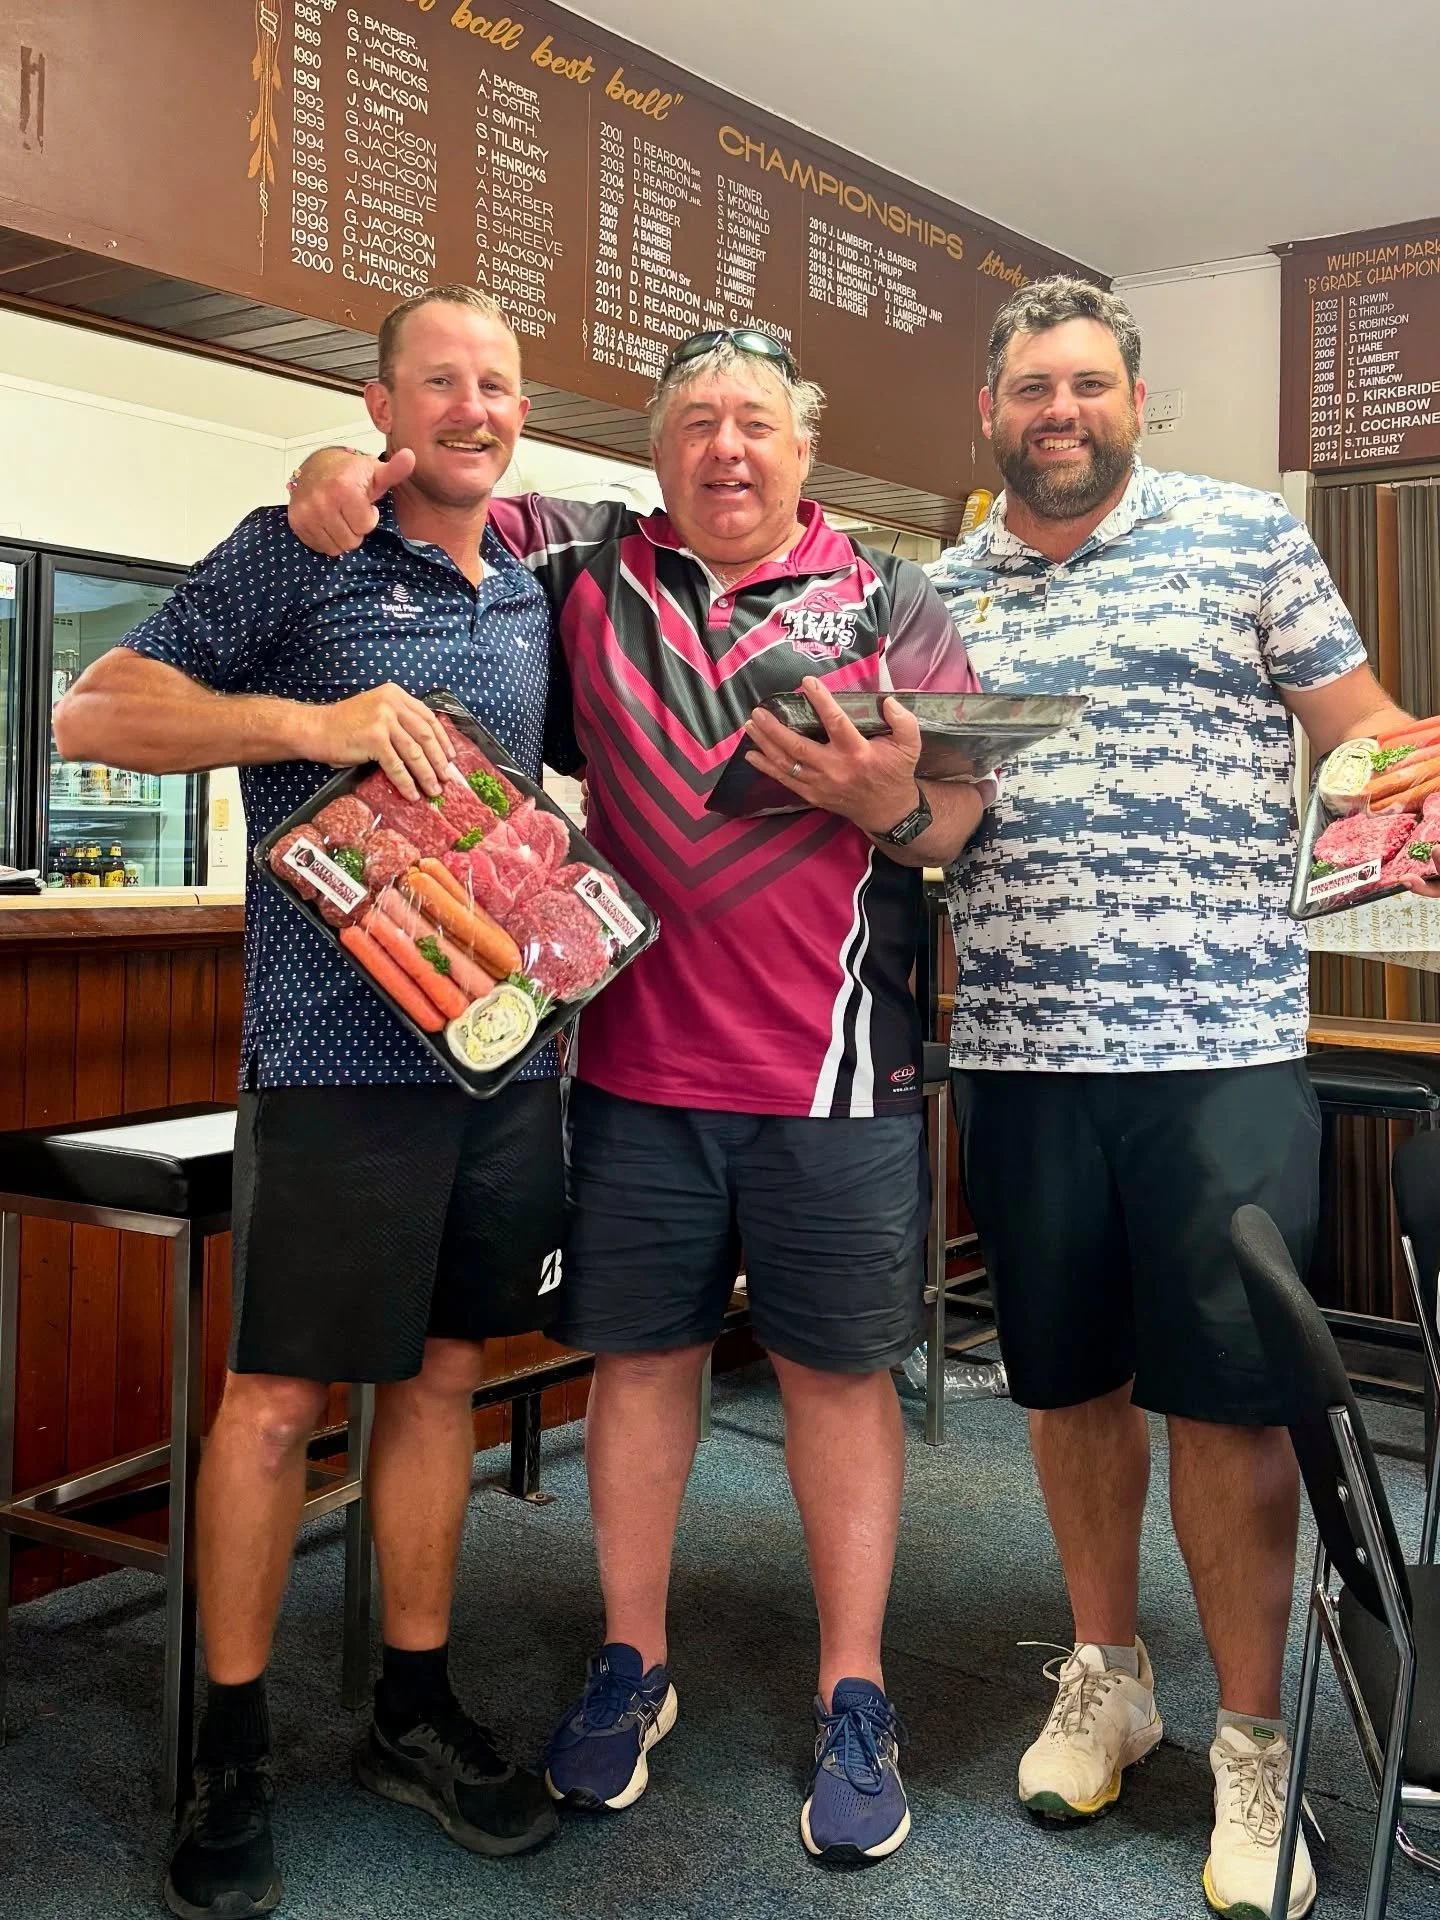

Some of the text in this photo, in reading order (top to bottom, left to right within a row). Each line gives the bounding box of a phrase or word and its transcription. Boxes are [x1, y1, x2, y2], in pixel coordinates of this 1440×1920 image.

[294, 1, 321, 26] 1988
[294, 22, 321, 46] 1989
[294, 45, 321, 69] 1990
[451, 1, 524, 50] ball
[530, 35, 595, 84] best
[294, 68, 547, 184] 1991 SMITH HENRICKS
[294, 88, 533, 192] 1992 RUDD
[293, 128, 553, 236] 1994 BARBER
[294, 107, 553, 218] 1993 BARBER
[600, 121, 762, 205] 2001 REARDON TURNER
[600, 138, 625, 159] 2002
[643, 157, 691, 188] REARDON
[600, 154, 624, 174] 2003
[643, 172, 688, 201] REARDON
[292, 149, 327, 173] 1995
[492, 220, 563, 257] SHREEVE
[600, 170, 624, 190] 2004
[727, 222, 761, 246] SABINE
[718, 125, 963, 261] CHAMPIONSHIPS
[292, 169, 328, 193] 1996
[492, 240, 553, 271] JACKSON
[292, 190, 545, 287] 1997 JACKSON BARBER
[599, 201, 757, 272] 2006 BARBER LAMBERT
[600, 186, 766, 262] 2005 BARBER LAMBERT
[291, 228, 329, 251] 1999
[360, 250, 429, 284] HENRICKS
[291, 247, 333, 273] 2000
[292, 207, 546, 305] 1998 JACKSON BARBER
[598, 228, 756, 298] 2008 BARBER LAMBERT
[599, 215, 757, 285] 2007 BARBER LAMBERT
[809, 216, 917, 272] 2016 LAMBERT BARBER
[809, 232, 903, 279] 2017 RUDD THRUPP
[1327, 245, 1399, 272] WHIPHAM
[595, 259, 622, 280] 2010
[630, 270, 641, 288] D.
[644, 275, 701, 309] REARDON
[703, 298, 725, 318] JNR
[598, 243, 618, 260] 2009
[640, 258, 678, 283] REARDON
[723, 289, 753, 310] WELDON
[809, 247, 917, 300] 2018 LAMBERT BARBER
[809, 260, 826, 276] 2019
[893, 293, 928, 317] REARDON
[929, 309, 943, 324] JNR
[1320, 271, 1362, 292] GRADE
[595, 279, 621, 300] 2011
[629, 289, 640, 307] D.
[643, 294, 700, 327] REARDON
[595, 297, 623, 320] 2012
[629, 309, 640, 326] D.
[809, 273, 926, 328] 2020 BARBER LAMBERT
[809, 285, 914, 335] 2021 BARDEN HOOK
[1314, 292, 1389, 312] 2002 IRWIN
[1314, 303, 1395, 324] 2003 THRUPP
[593, 321, 616, 339] 2013
[1314, 313, 1409, 336] 2004 ROBINSON
[1314, 327, 1398, 349] 2005 THRUPP
[592, 347, 616, 366] 2015
[593, 332, 665, 367] 2014 BARBER
[1313, 363, 1395, 383] 2008 THRUPP
[1314, 341, 1383, 360] 2006 HARE
[1314, 351, 1400, 371] 2007 LAMBERT
[1311, 380, 1440, 408] 2010 D. KIRKBRIDE
[1311, 398, 1431, 423] 2011 K RAINBOW
[1313, 383, 1334, 394] 2009
[1311, 412, 1440, 438] 2012 J. COCHRANE
[1313, 440, 1338, 452] 2013
[1312, 445, 1400, 463] 2014 LORENZ
[783, 609, 854, 630] MEAT
[787, 623, 854, 647] ANTS
